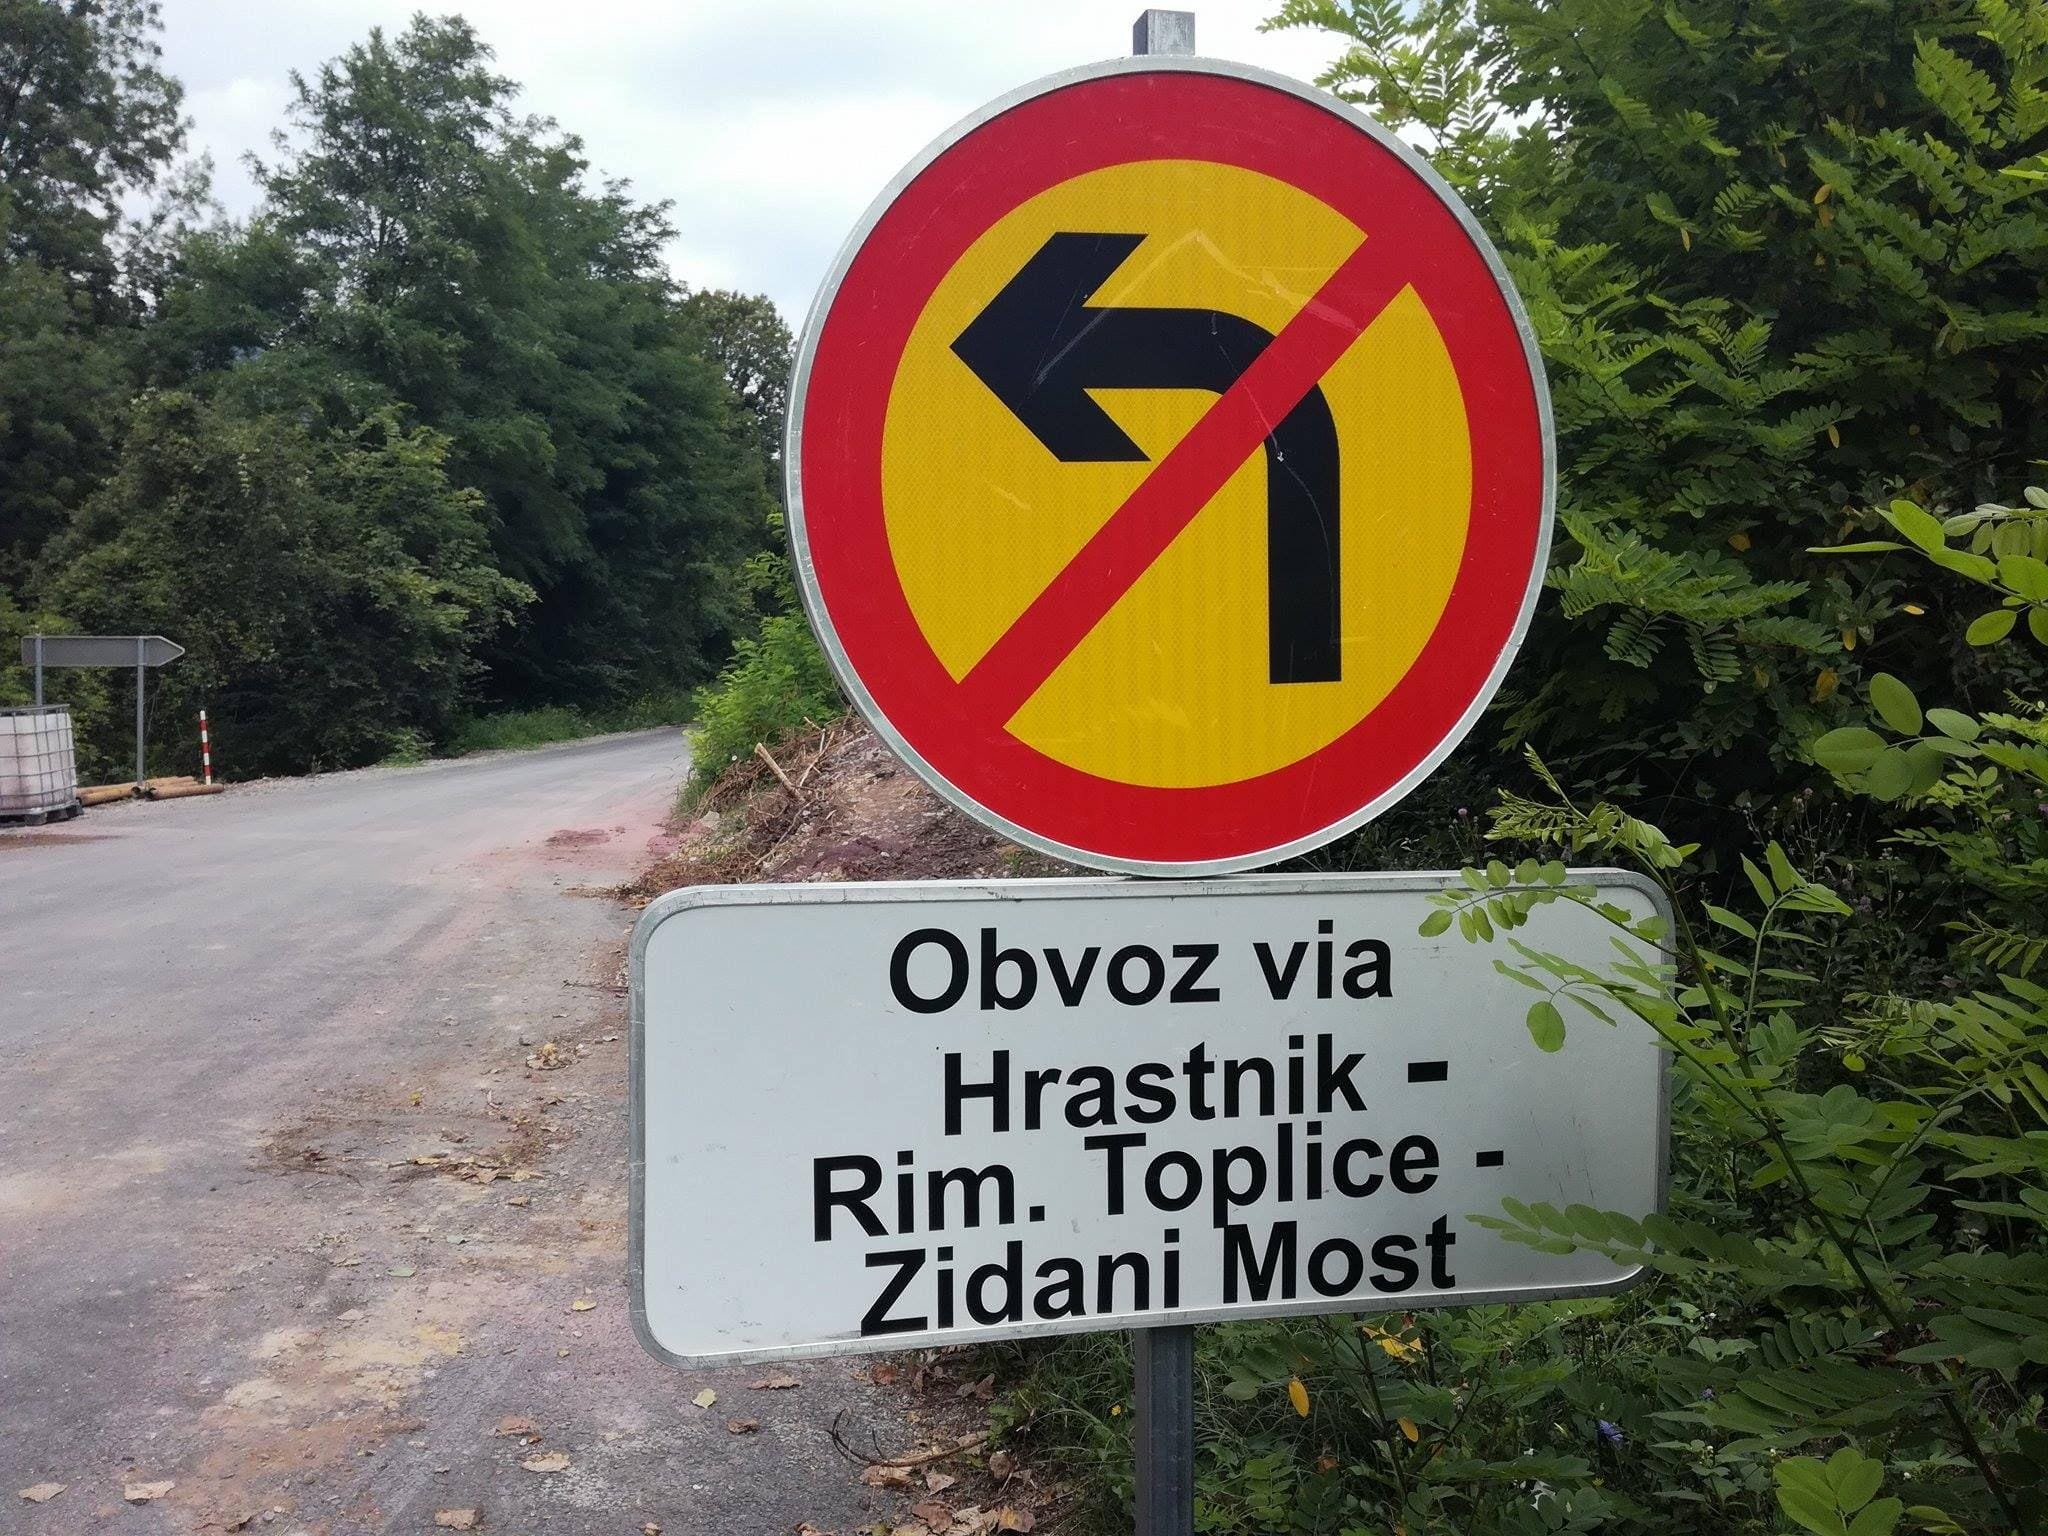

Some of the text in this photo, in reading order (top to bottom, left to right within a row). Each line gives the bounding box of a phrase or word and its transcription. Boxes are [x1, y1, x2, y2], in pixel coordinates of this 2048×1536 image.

[889, 919, 1393, 1014] Obvoz via
[944, 1033, 1368, 1136] Hrastnik
[813, 1149, 1046, 1243] Rim.
[1084, 1120, 1440, 1229] Toplice
[860, 1213, 1457, 1338] Zidani Most
